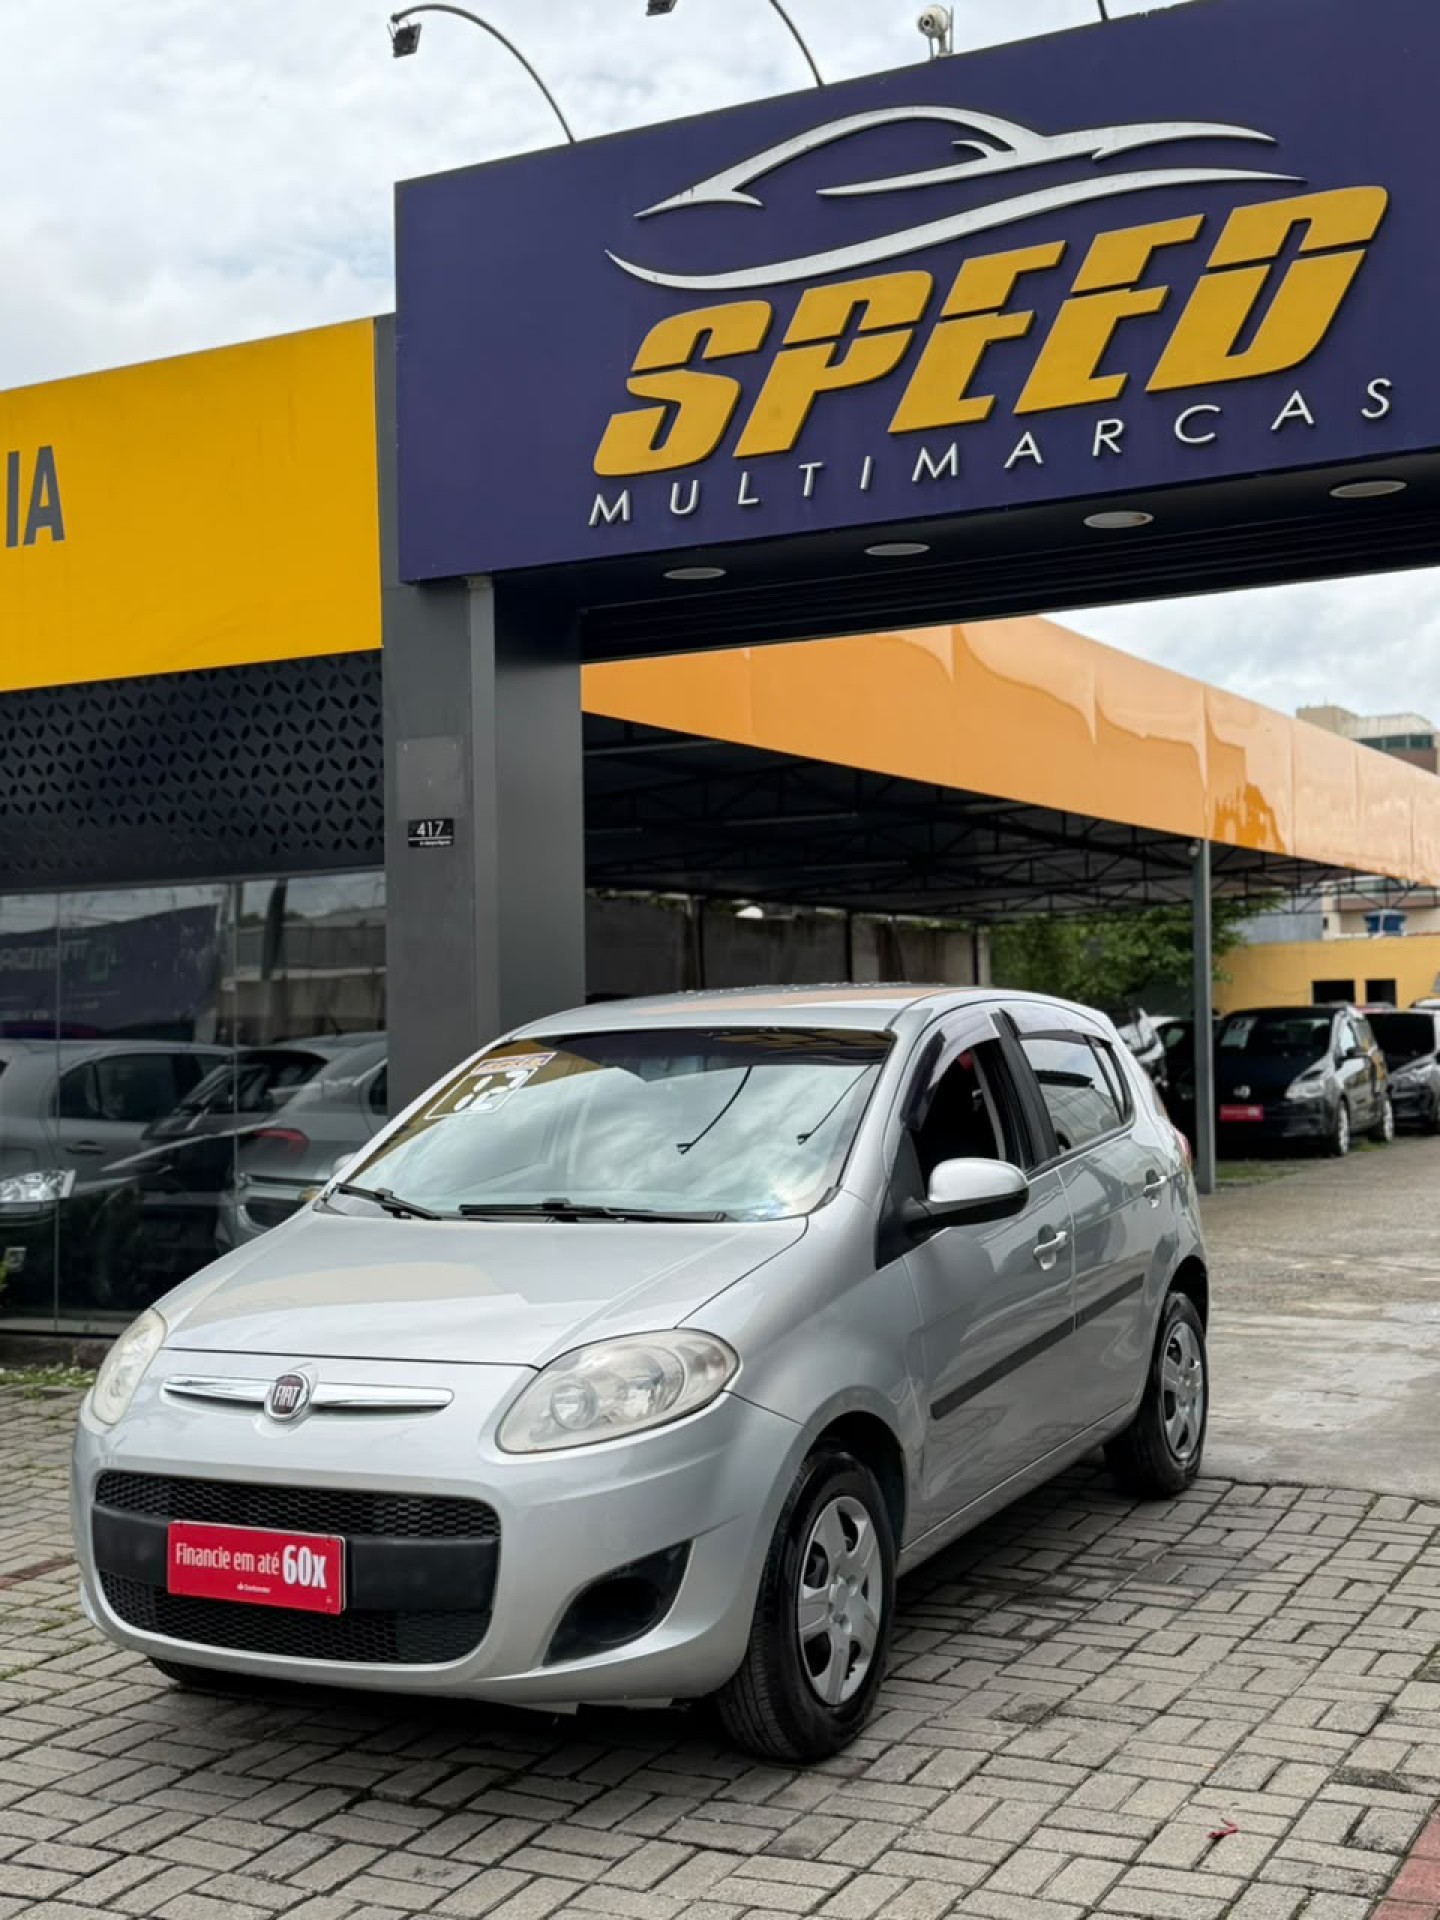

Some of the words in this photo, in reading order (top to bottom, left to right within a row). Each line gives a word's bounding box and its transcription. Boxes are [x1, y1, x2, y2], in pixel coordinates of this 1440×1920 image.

[593, 185, 1389, 476] SPEED
[588, 377, 1393, 528] MULTIMARCAS
[416, 820, 445, 838] 417
[273, 1385, 301, 1407] FIAT
[175, 1541, 231, 1571] Financie
[233, 1551, 255, 1573] em
[257, 1551, 280, 1576] até
[281, 1544, 328, 1590] 60x
